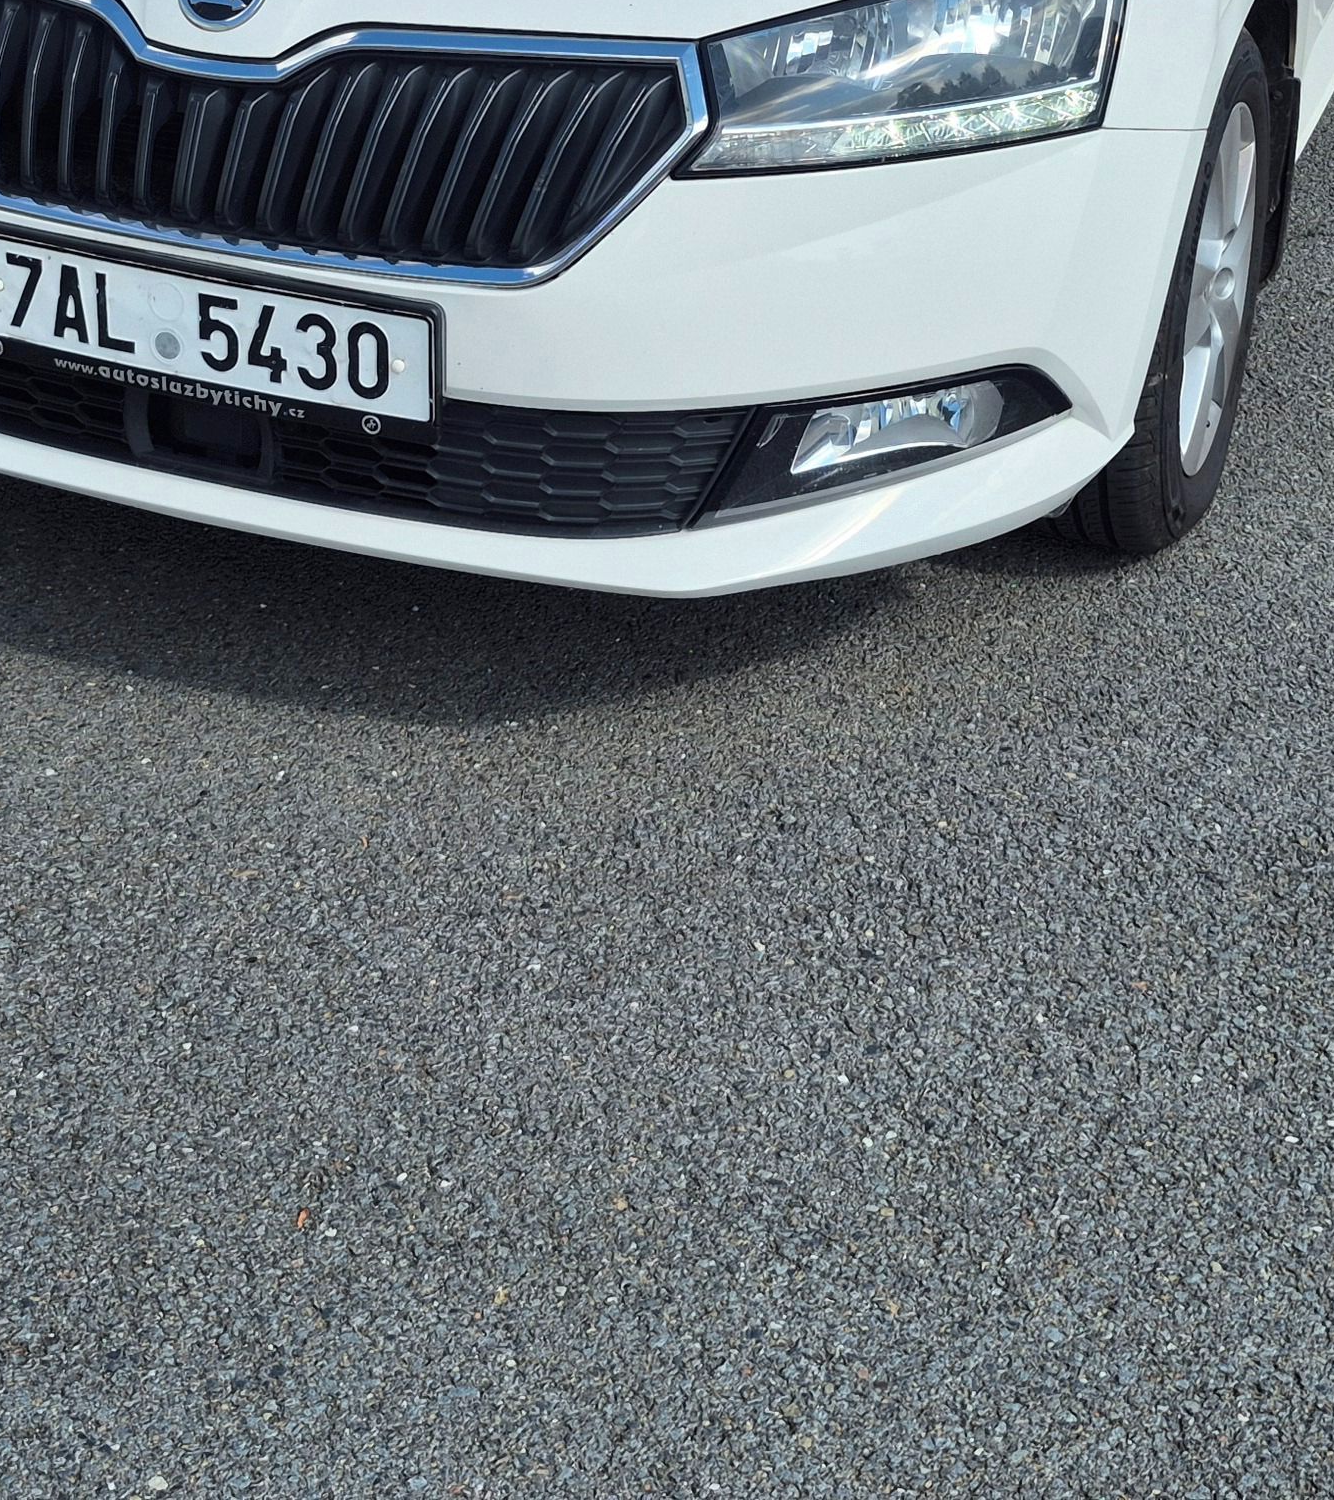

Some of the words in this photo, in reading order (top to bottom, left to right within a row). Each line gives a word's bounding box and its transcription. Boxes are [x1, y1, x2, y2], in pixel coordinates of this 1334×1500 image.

[6, 252, 136, 354] 7AL
[198, 293, 389, 399] 5430
[54, 357, 305, 419] www.autosluzbytichy.cz
